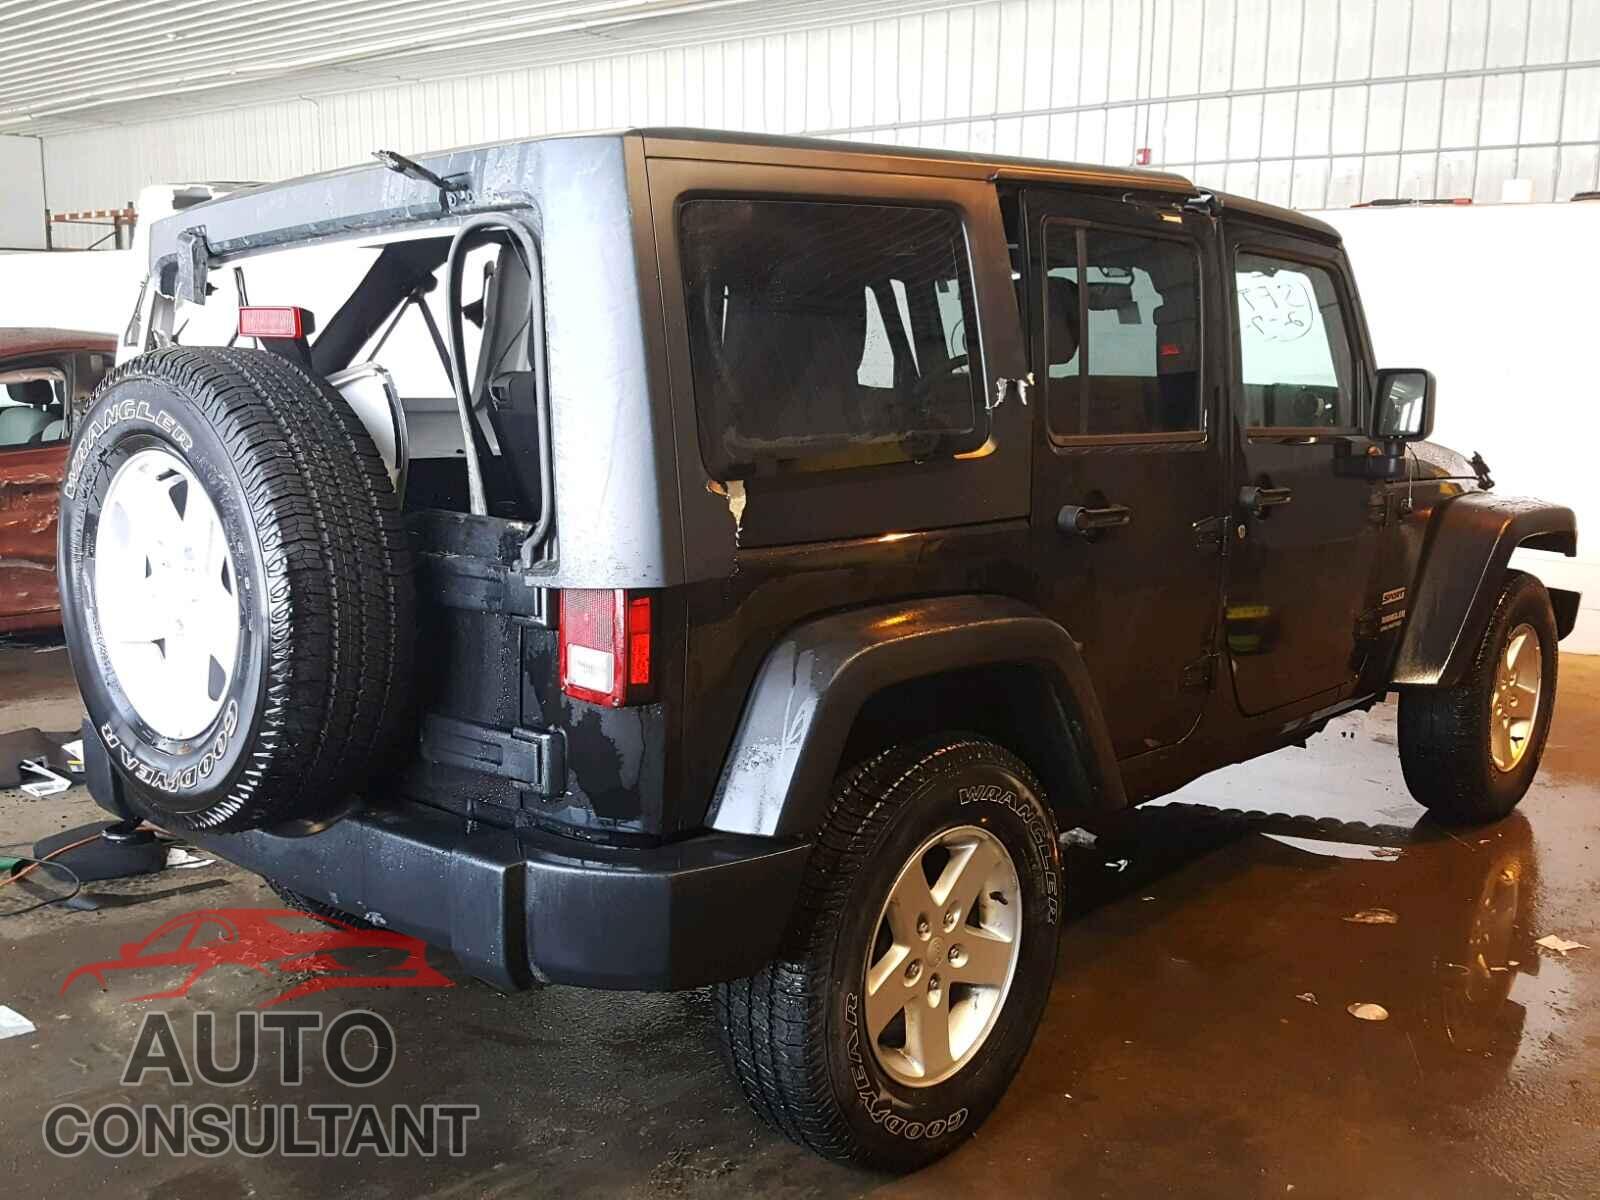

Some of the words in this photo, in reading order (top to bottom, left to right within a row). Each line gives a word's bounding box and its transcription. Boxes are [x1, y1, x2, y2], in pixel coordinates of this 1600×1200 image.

[64, 399, 194, 499] WRANGLER
[101, 700, 239, 793] GOODYEAR
[958, 785, 1058, 925] WRANGLER
[846, 992, 969, 1139] GOODYEAR
